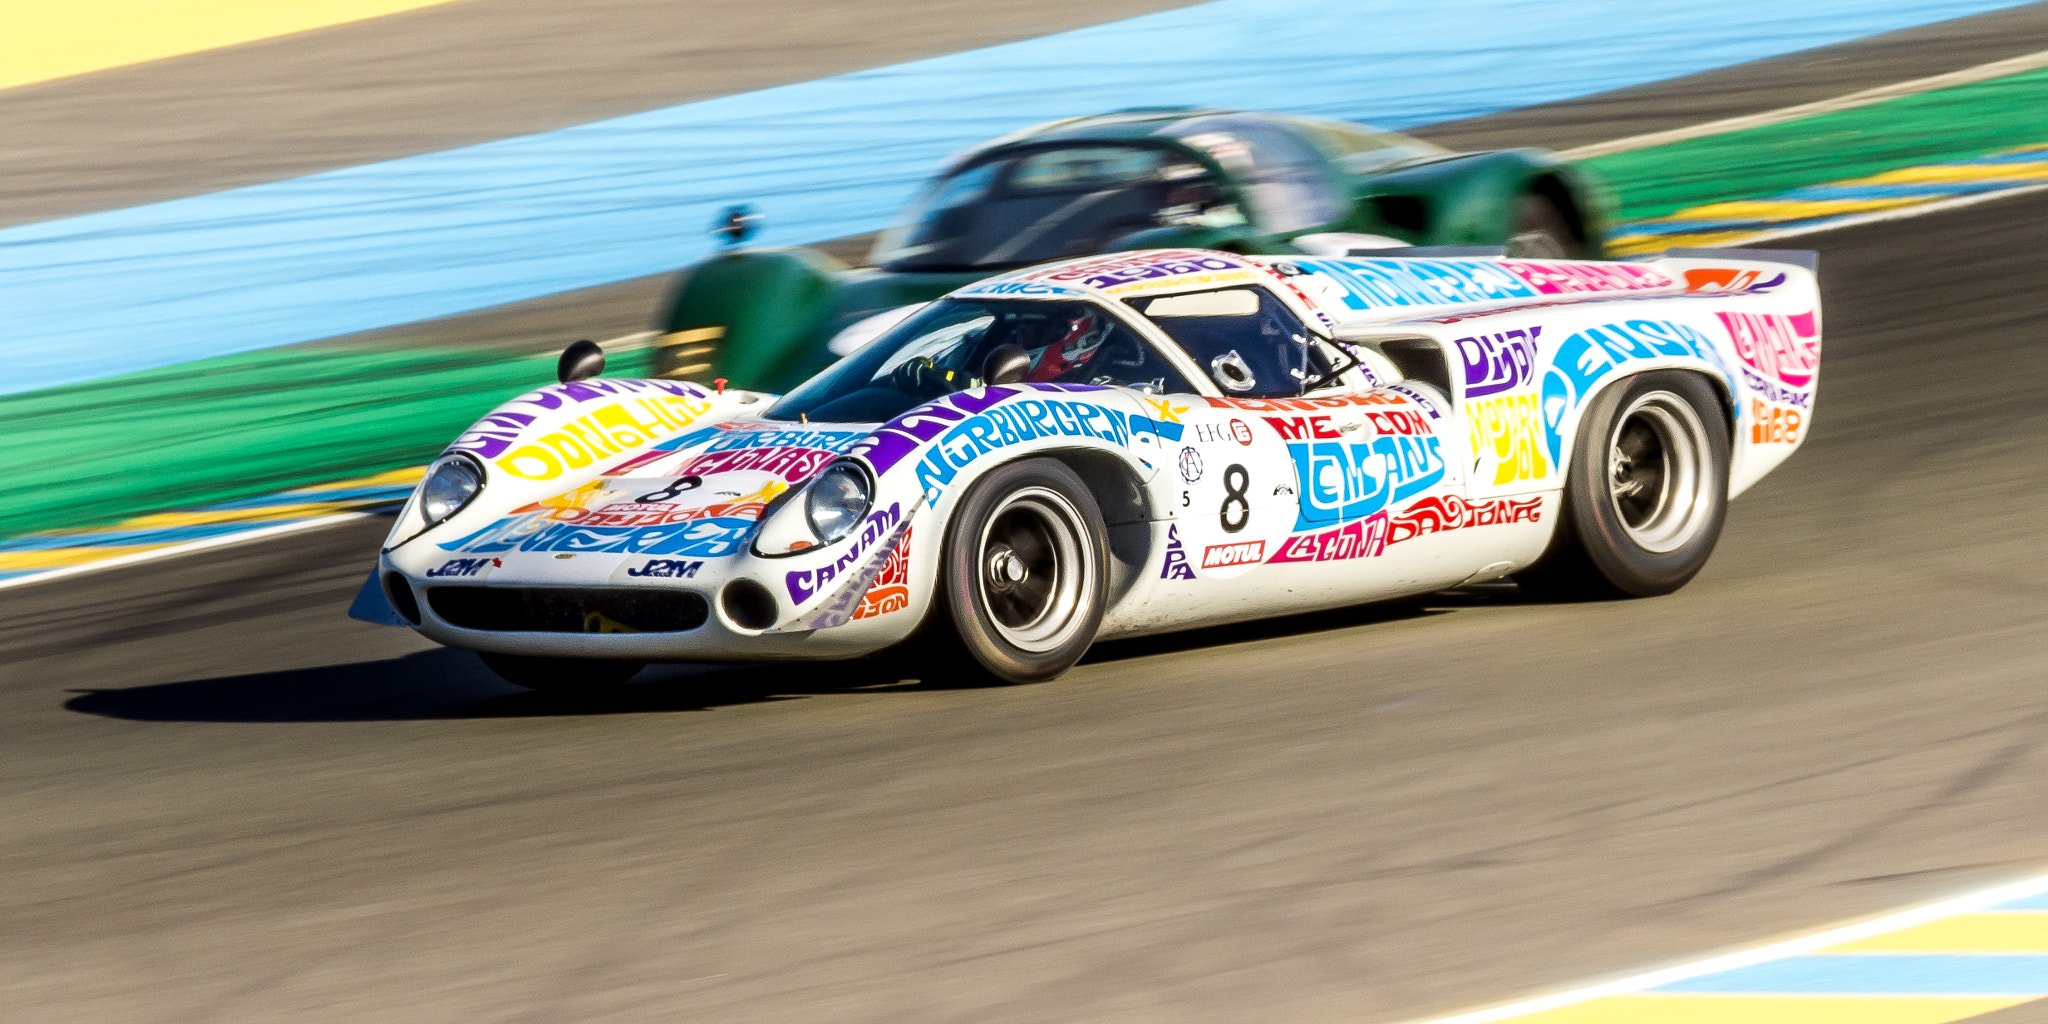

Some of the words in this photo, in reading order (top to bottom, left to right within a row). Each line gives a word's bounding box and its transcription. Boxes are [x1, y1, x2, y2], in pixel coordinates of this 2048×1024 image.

[635, 477, 702, 503] 8
[1182, 491, 1191, 507] 5
[1220, 463, 1250, 533] 8
[1387, 494, 1543, 546] DAYTONA
[1207, 543, 1263, 567] MOTUL
